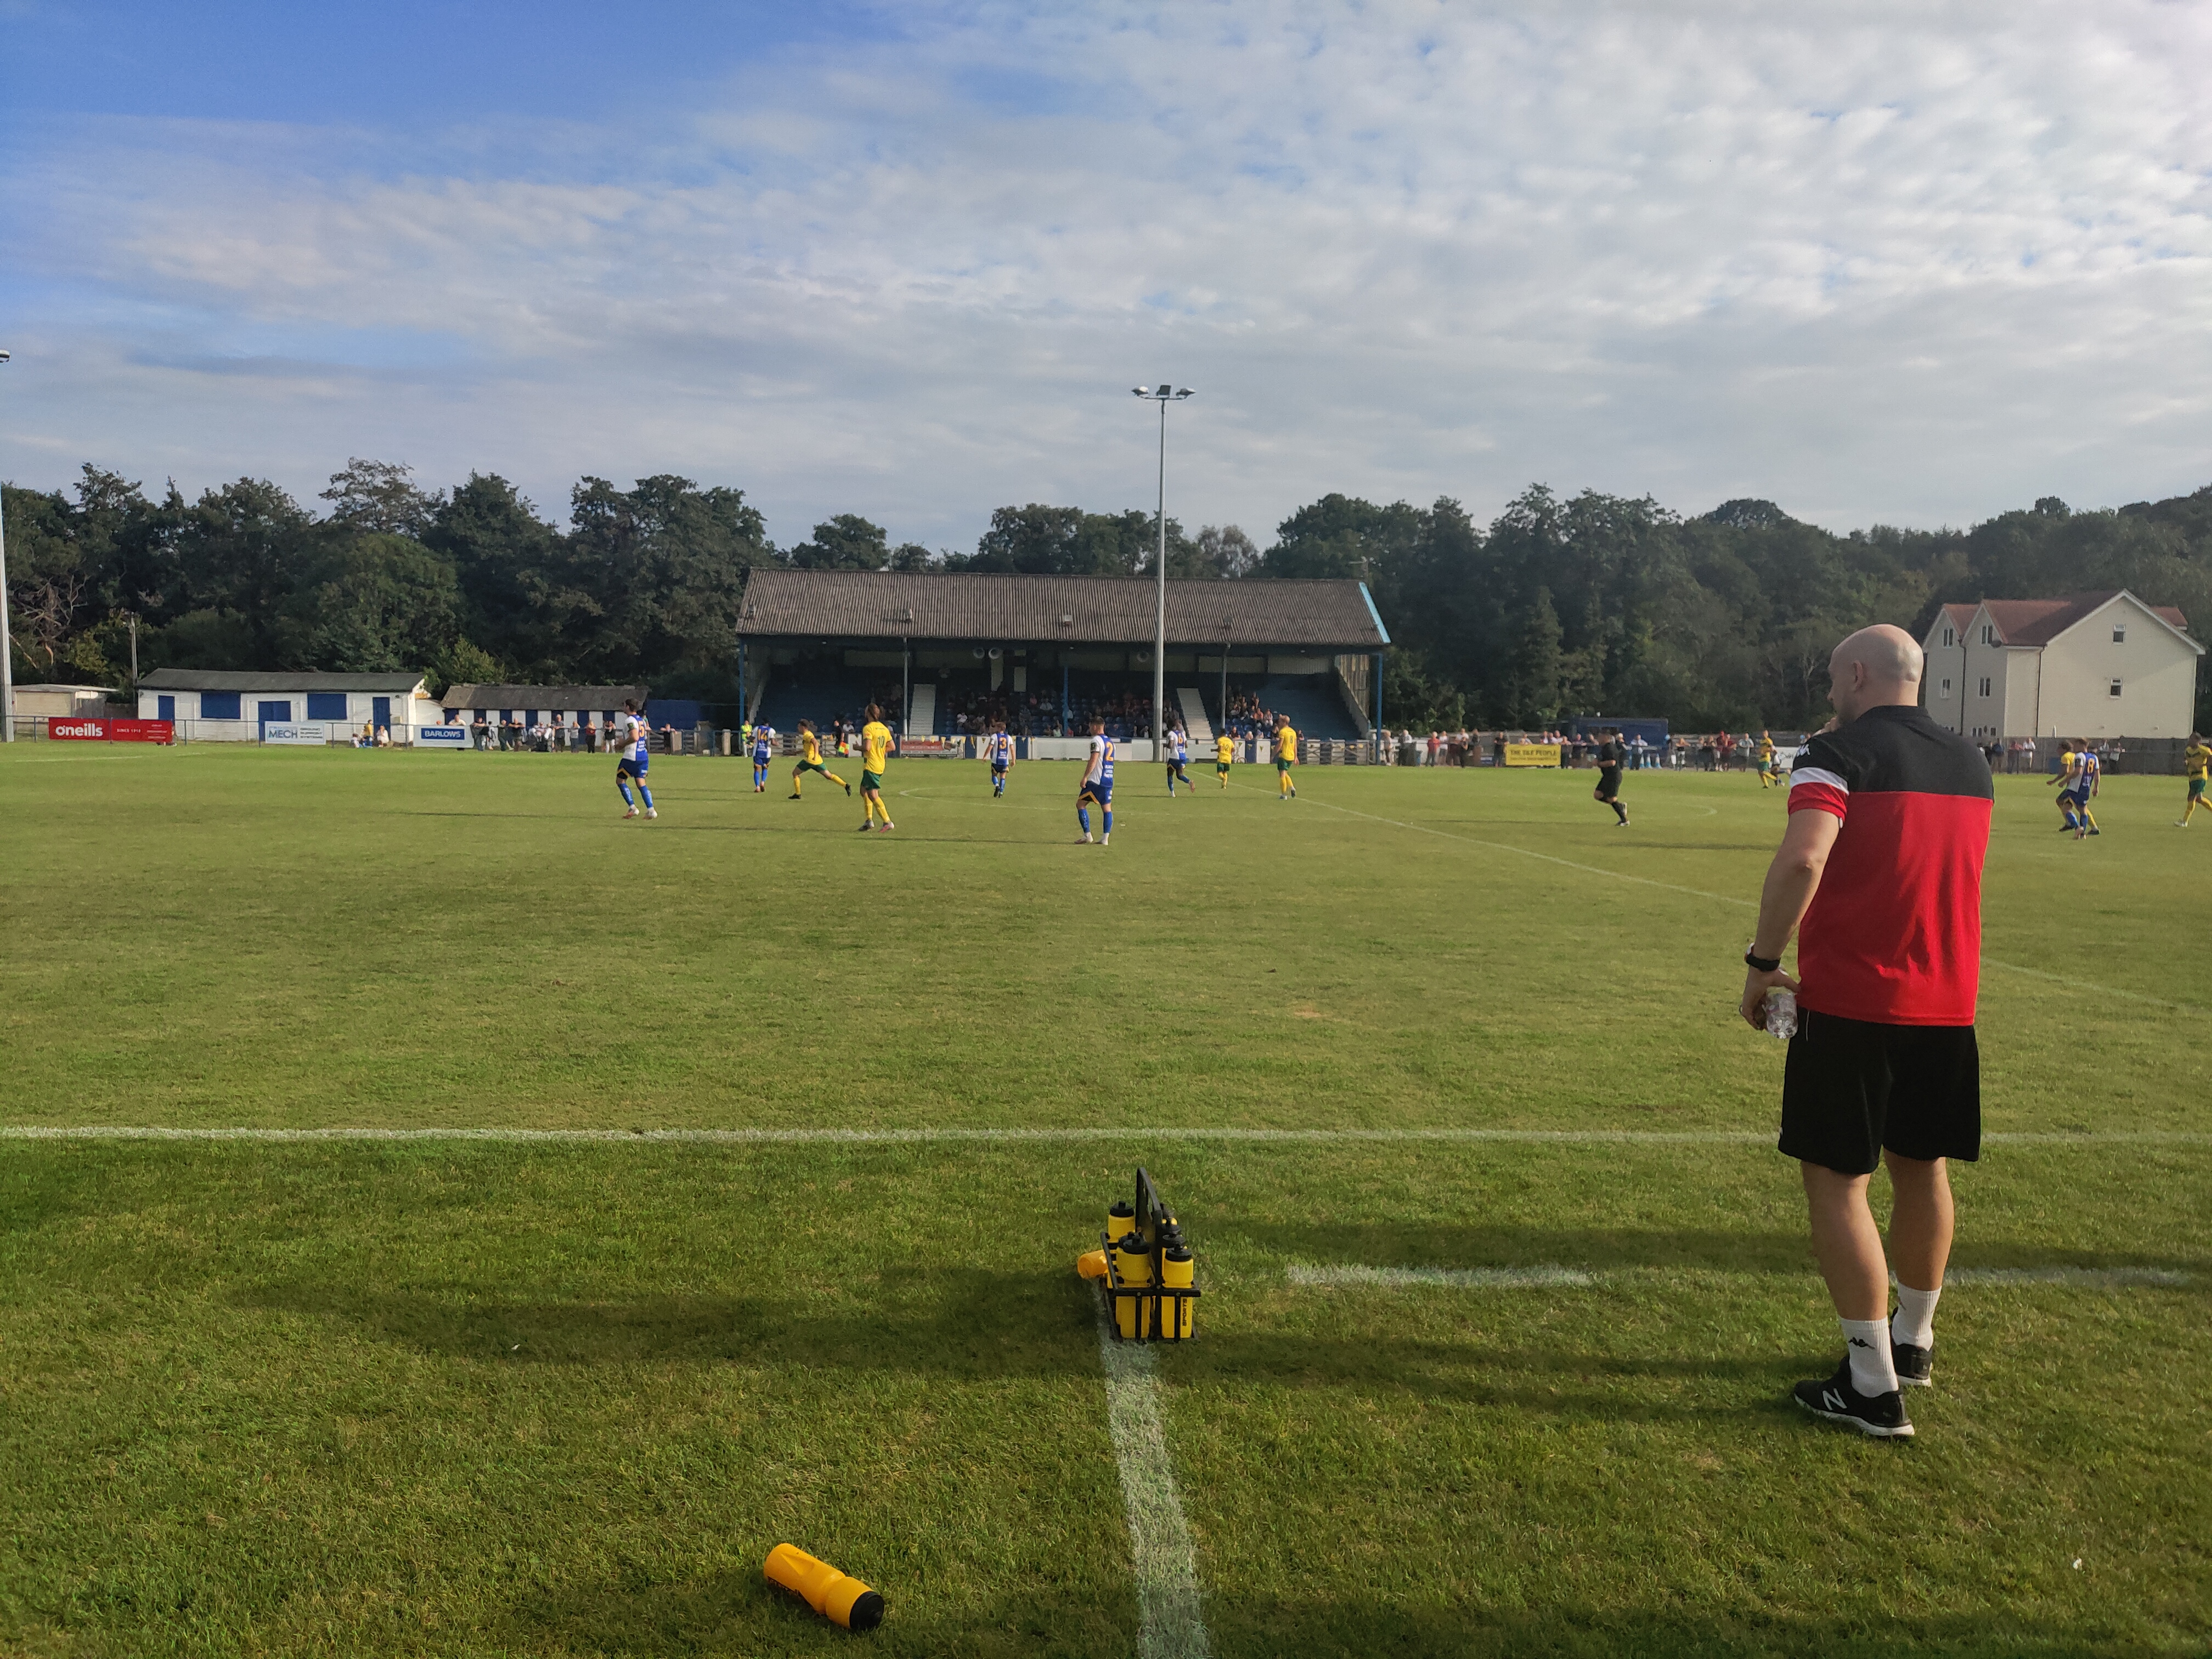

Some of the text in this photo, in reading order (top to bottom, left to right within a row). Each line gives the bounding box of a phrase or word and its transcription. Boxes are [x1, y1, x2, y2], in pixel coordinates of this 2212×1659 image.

[268, 730, 298, 739] MECH
[639, 720, 645, 737] 5
[758, 728, 768, 741] 14
[878, 735, 885, 748] 10
[999, 737, 1007, 749] 3
[1178, 732, 1183, 744] 6
[1105, 741, 1114, 761] 2
